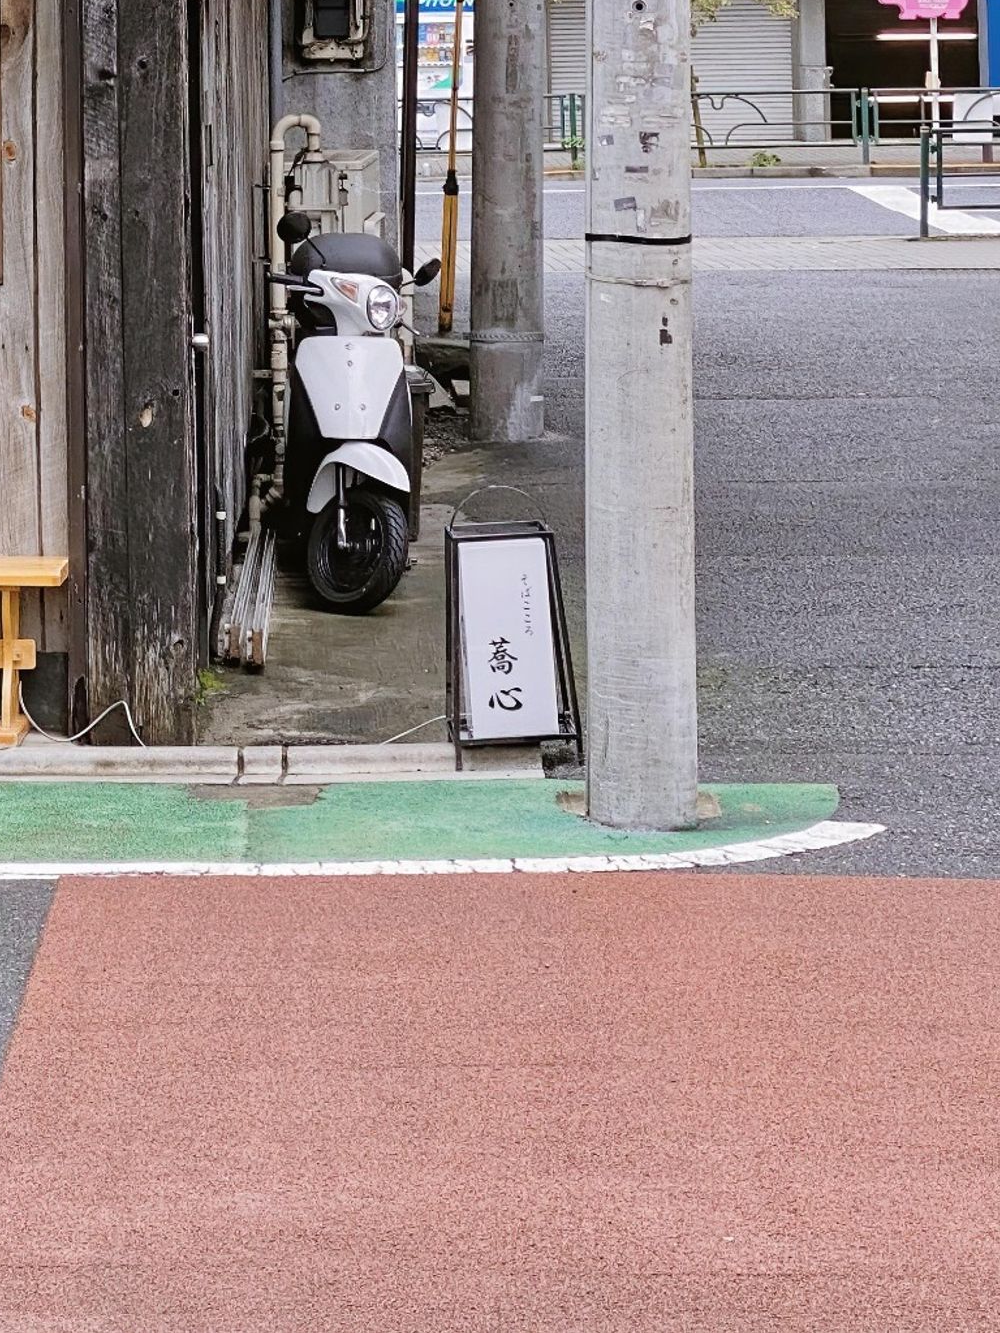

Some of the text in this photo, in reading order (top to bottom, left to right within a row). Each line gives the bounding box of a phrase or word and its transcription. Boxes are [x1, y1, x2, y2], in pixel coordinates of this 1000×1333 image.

[520, 573, 534, 636] そばこころ
[488, 636, 523, 711] 蕎心
